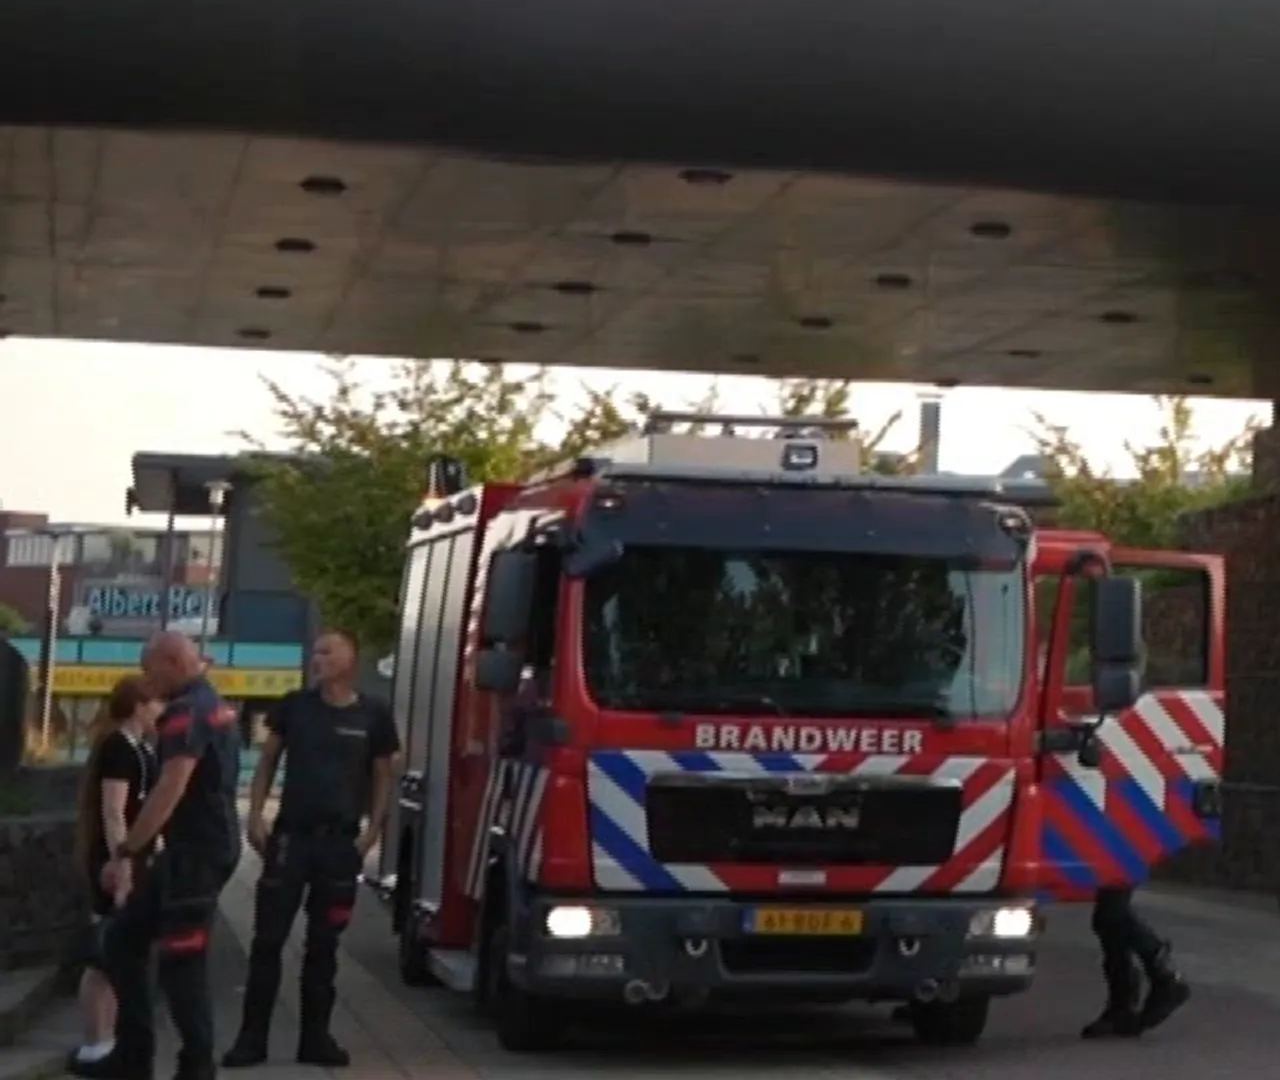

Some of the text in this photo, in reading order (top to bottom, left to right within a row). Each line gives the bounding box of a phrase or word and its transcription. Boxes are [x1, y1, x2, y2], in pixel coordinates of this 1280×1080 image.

[88, 585, 161, 617] Albert
[695, 723, 923, 753] BRANDWEER
[752, 806, 861, 829] MAN
